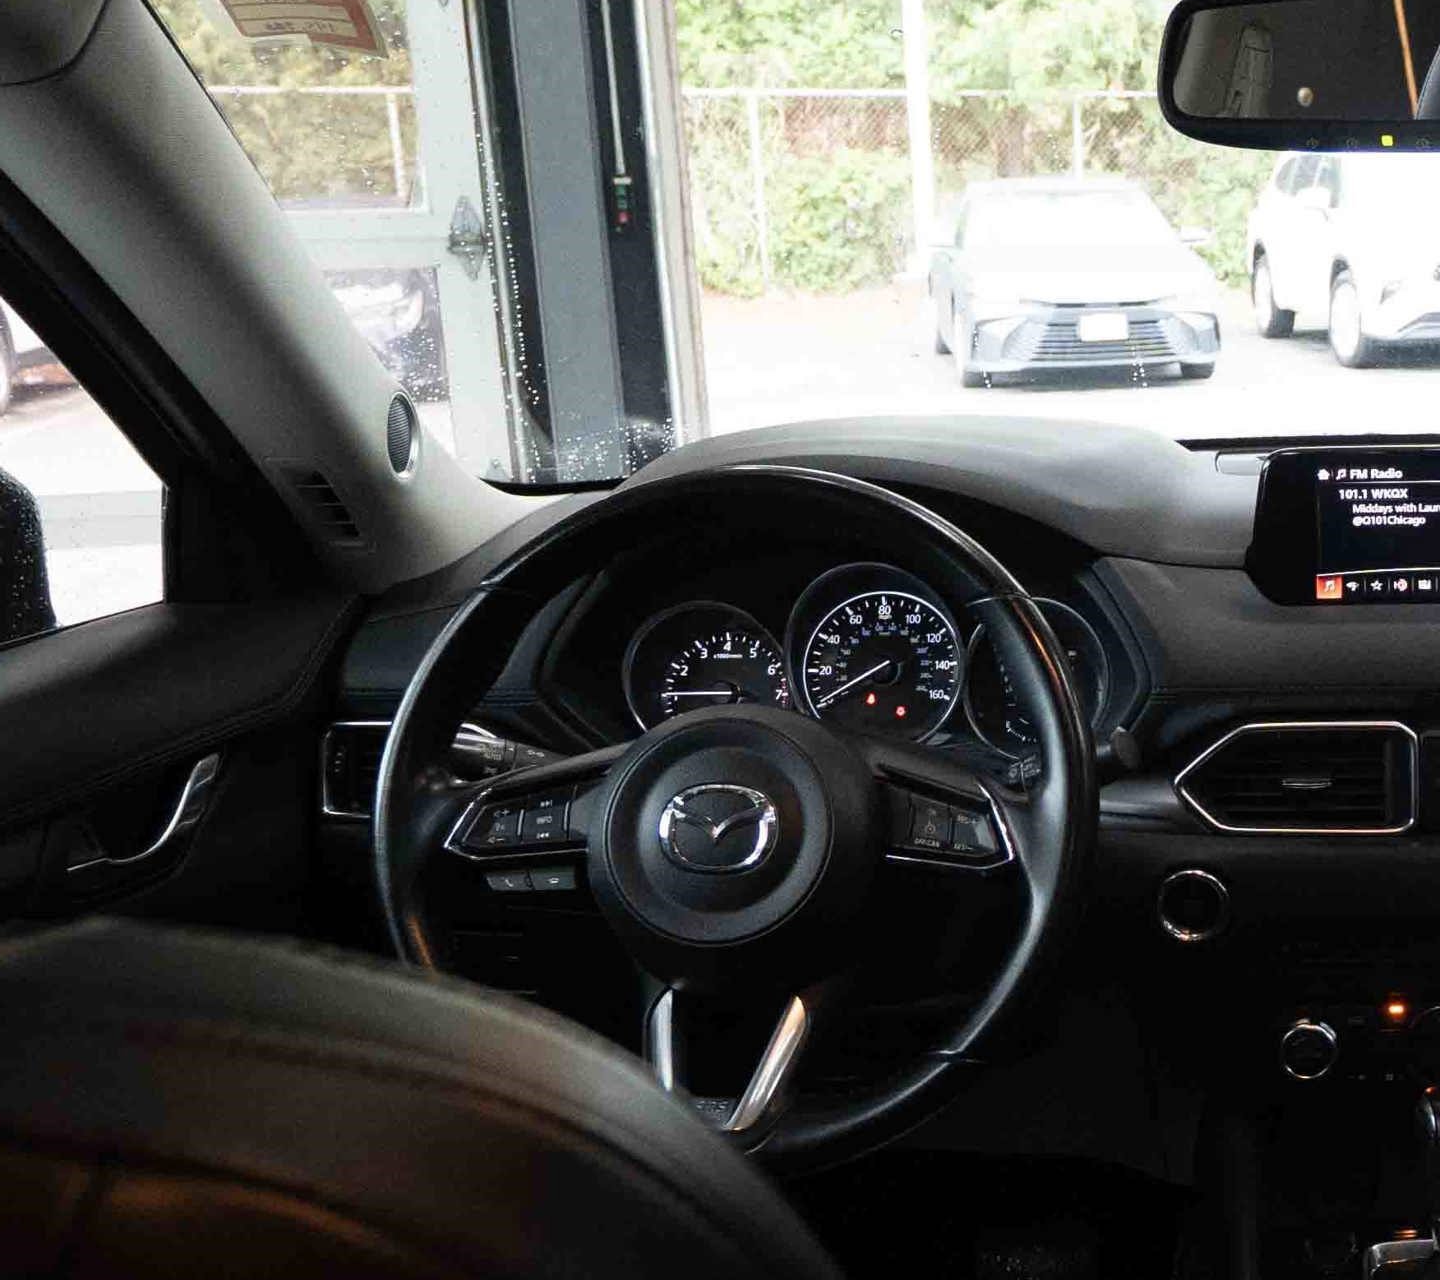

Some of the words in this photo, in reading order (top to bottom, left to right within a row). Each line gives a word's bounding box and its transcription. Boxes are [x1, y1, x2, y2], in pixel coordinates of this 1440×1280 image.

[1350, 468, 1368, 479] FM
[1370, 468, 1403, 479] Radio
[1339, 488, 1368, 499] 101.1
[1371, 488, 1408, 500] WKQX
[1352, 503, 1393, 515] Middays
[1395, 502, 1417, 513] with
[1352, 515, 1426, 527] @Q101Chicago
[878, 605, 892, 615] 80
[849, 615, 863, 624] 60
[905, 614, 921, 624] 100
[827, 635, 840, 644] 40
[926, 633, 942, 643] 120
[723, 641, 731, 651] 4
[700, 648, 708, 659] 3
[749, 648, 757, 658] 5
[768, 664, 776, 675] 6
[935, 660, 950, 670] 140
[680, 665, 688, 676] 2
[819, 666, 832, 675] 20
[776, 689, 783, 700] 7
[929, 689, 945, 700] 160
